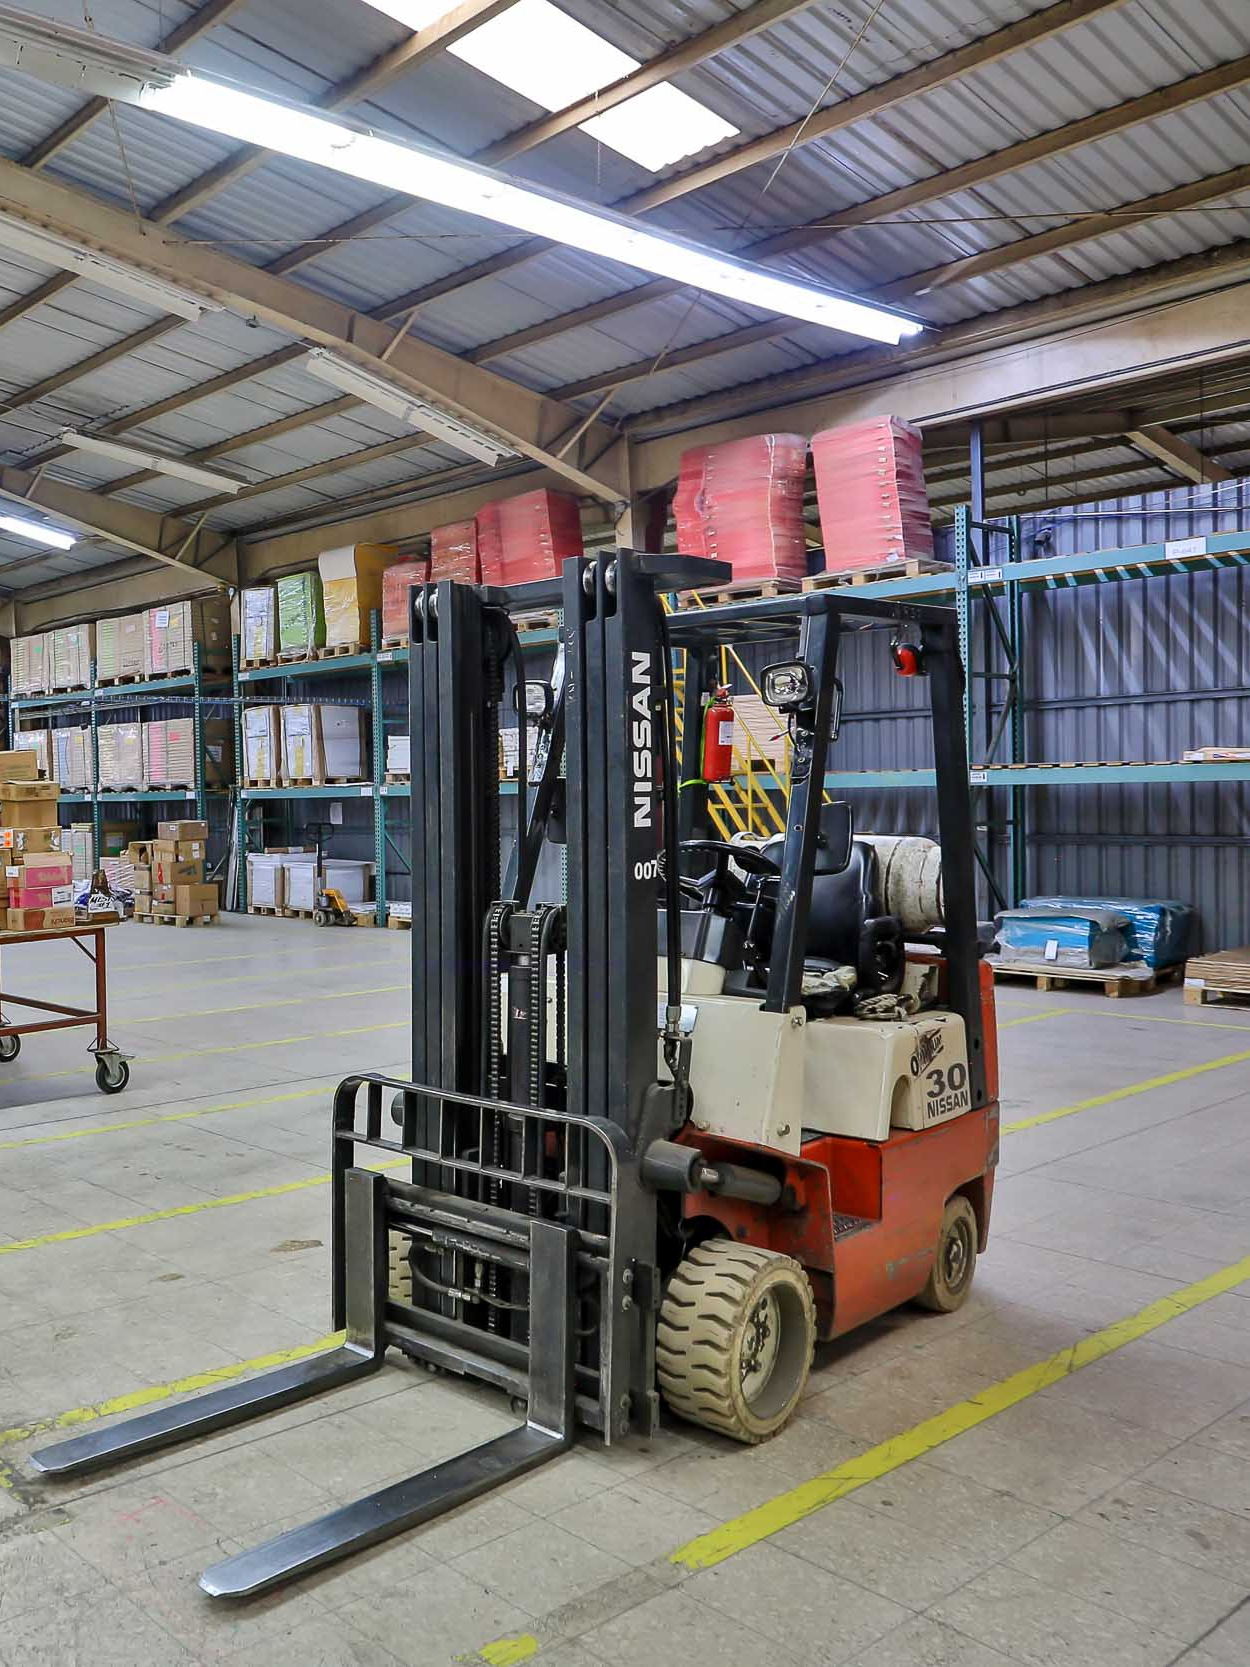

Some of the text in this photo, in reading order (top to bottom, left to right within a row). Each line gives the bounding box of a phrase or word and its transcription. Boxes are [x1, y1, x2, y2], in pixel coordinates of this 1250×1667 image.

[631, 651, 653, 828] NISSAN
[634, 859, 658, 881] 007
[926, 1062, 966, 1098] 30
[927, 1090, 968, 1119] NISSAN
